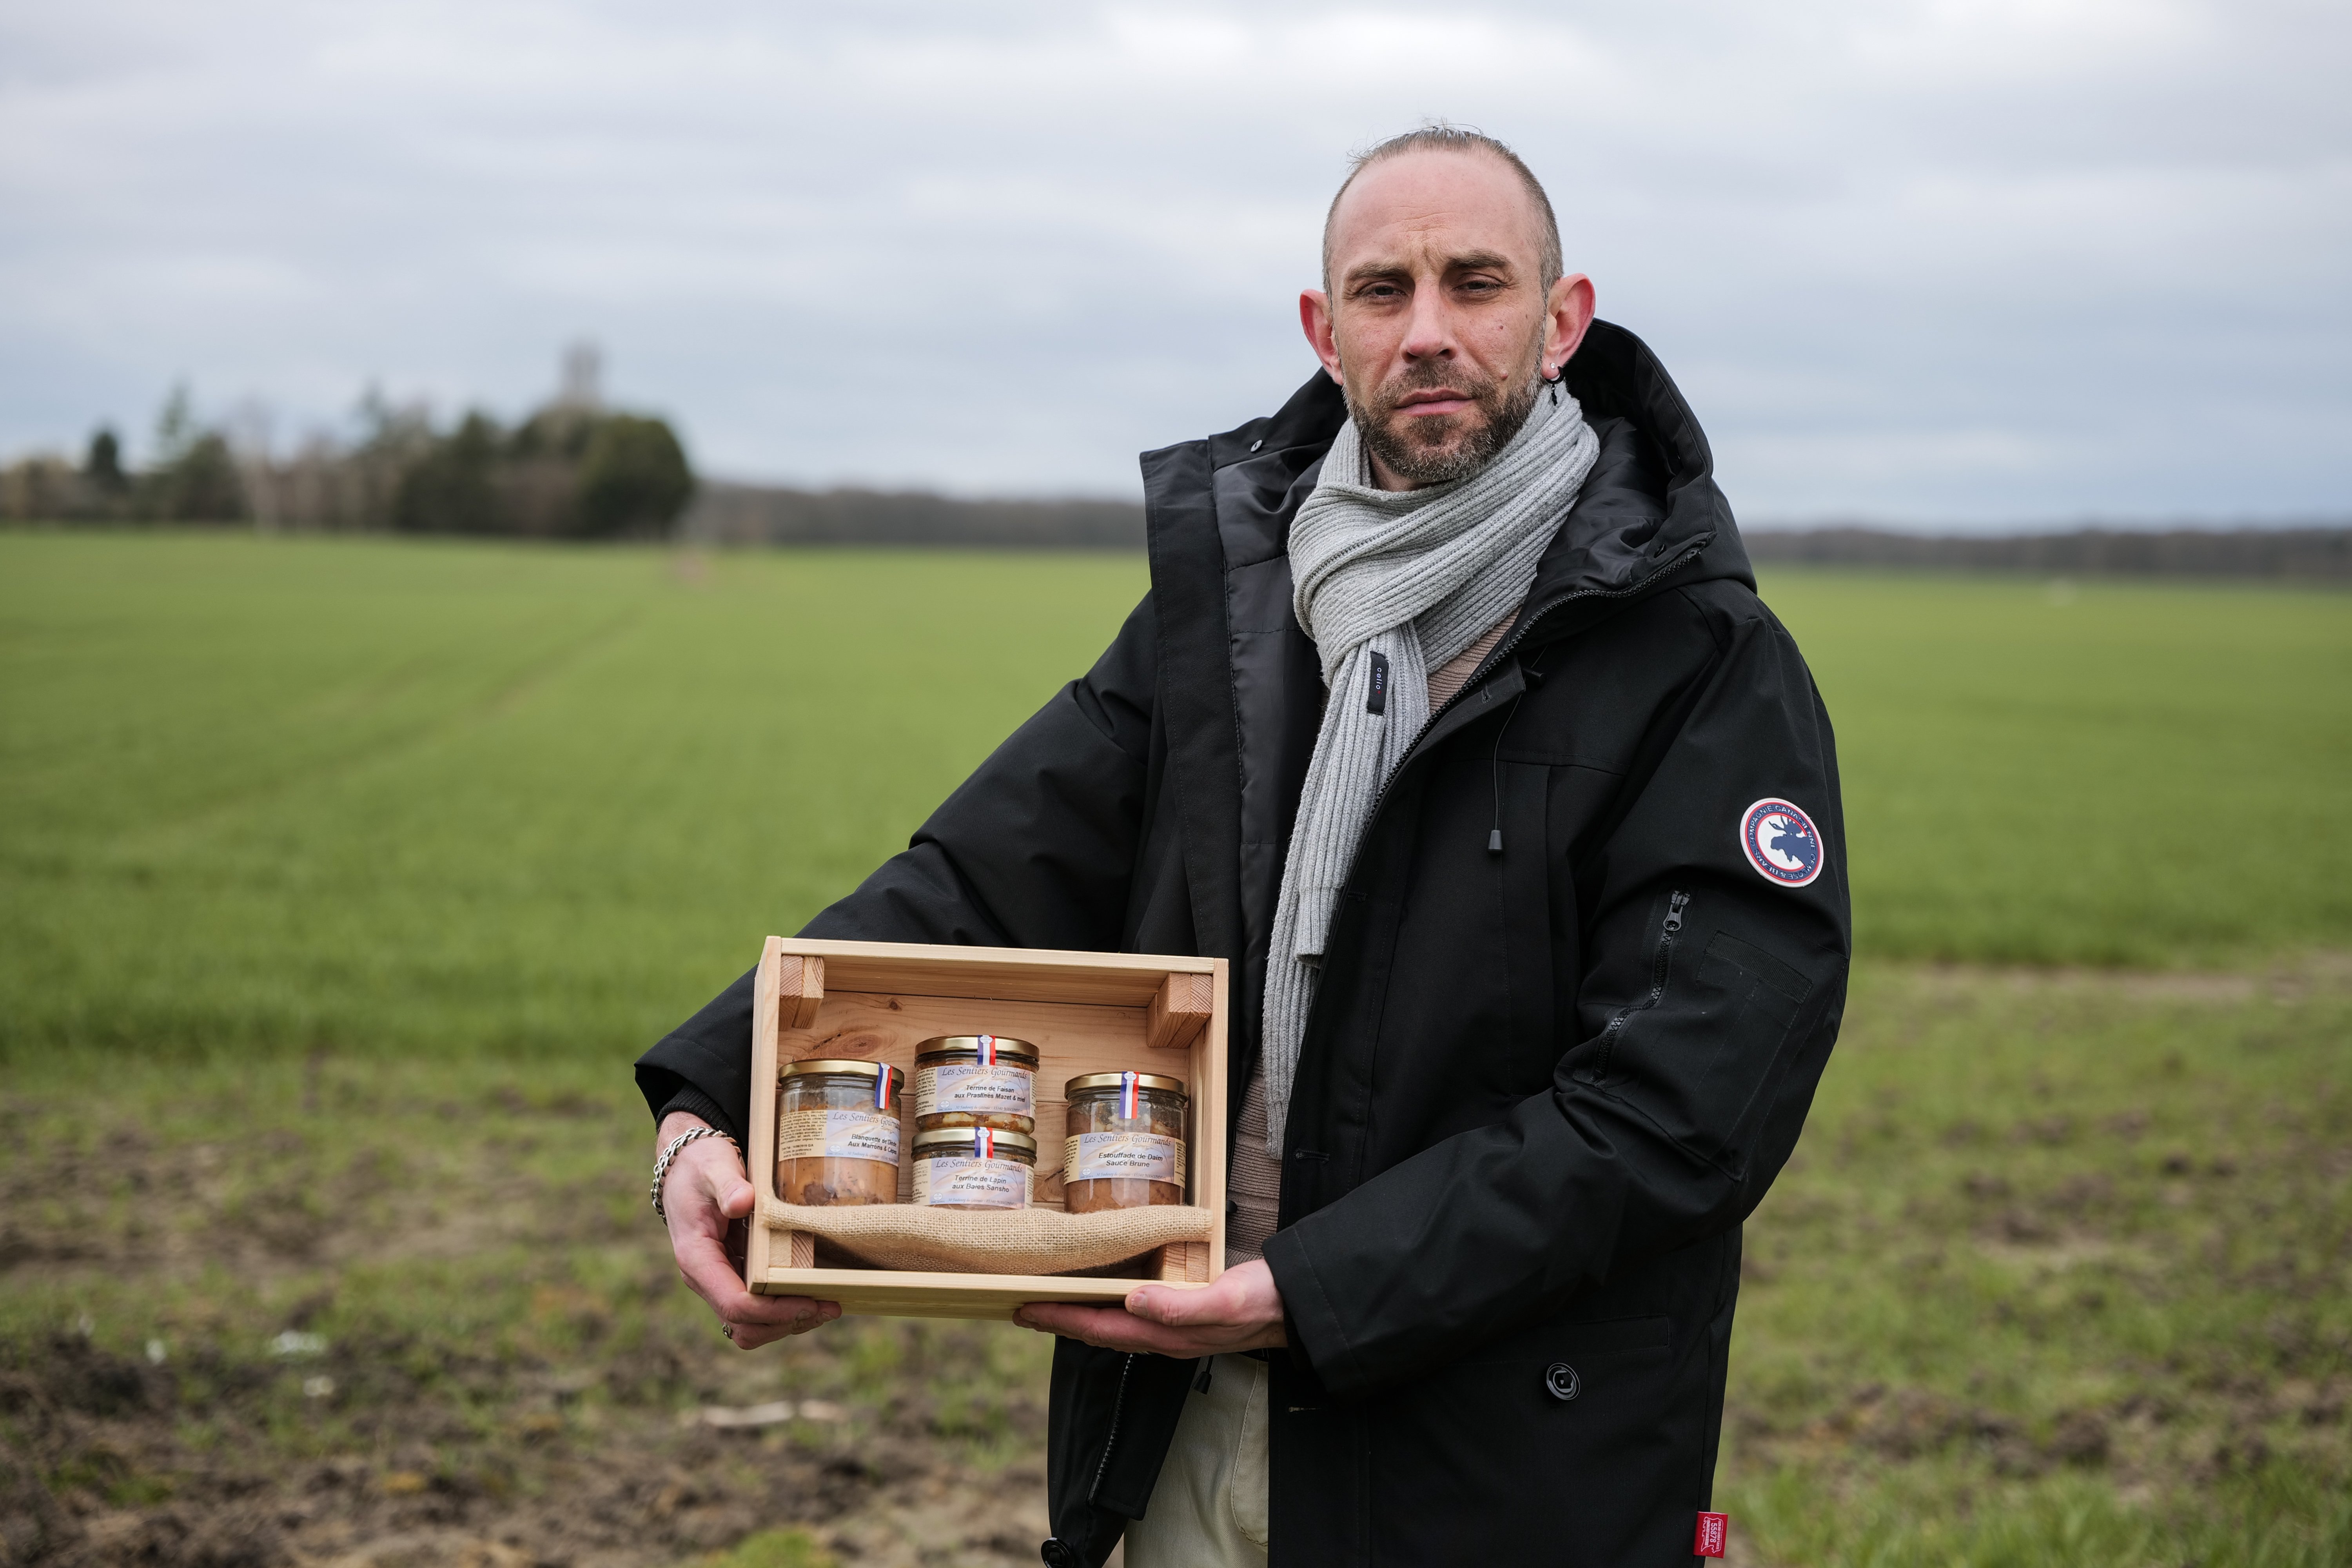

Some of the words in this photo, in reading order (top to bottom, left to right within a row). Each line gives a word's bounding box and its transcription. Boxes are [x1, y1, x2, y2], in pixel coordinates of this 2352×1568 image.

[1749, 805, 1773, 846] COMPAGNIE
[1775, 805, 1816, 851] CANADIENNE
[1755, 849, 1778, 875] BEARS
[1811, 853, 1816, 865] OF
[1788, 864, 1812, 879] MOOSE
[956, 1067, 988, 1076] Sentiers
[991, 1068, 1027, 1079] Gourmands
[832, 1112, 848, 1120] Les
[849, 1113, 878, 1123] Sentiers
[851, 1134, 880, 1142] Blanquette
[1098, 1134, 1129, 1143] Sentiers
[1132, 1134, 1171, 1146] Gourmands
[950, 1159, 982, 1168] Sentiers
[985, 1160, 1022, 1172] Gourmands
